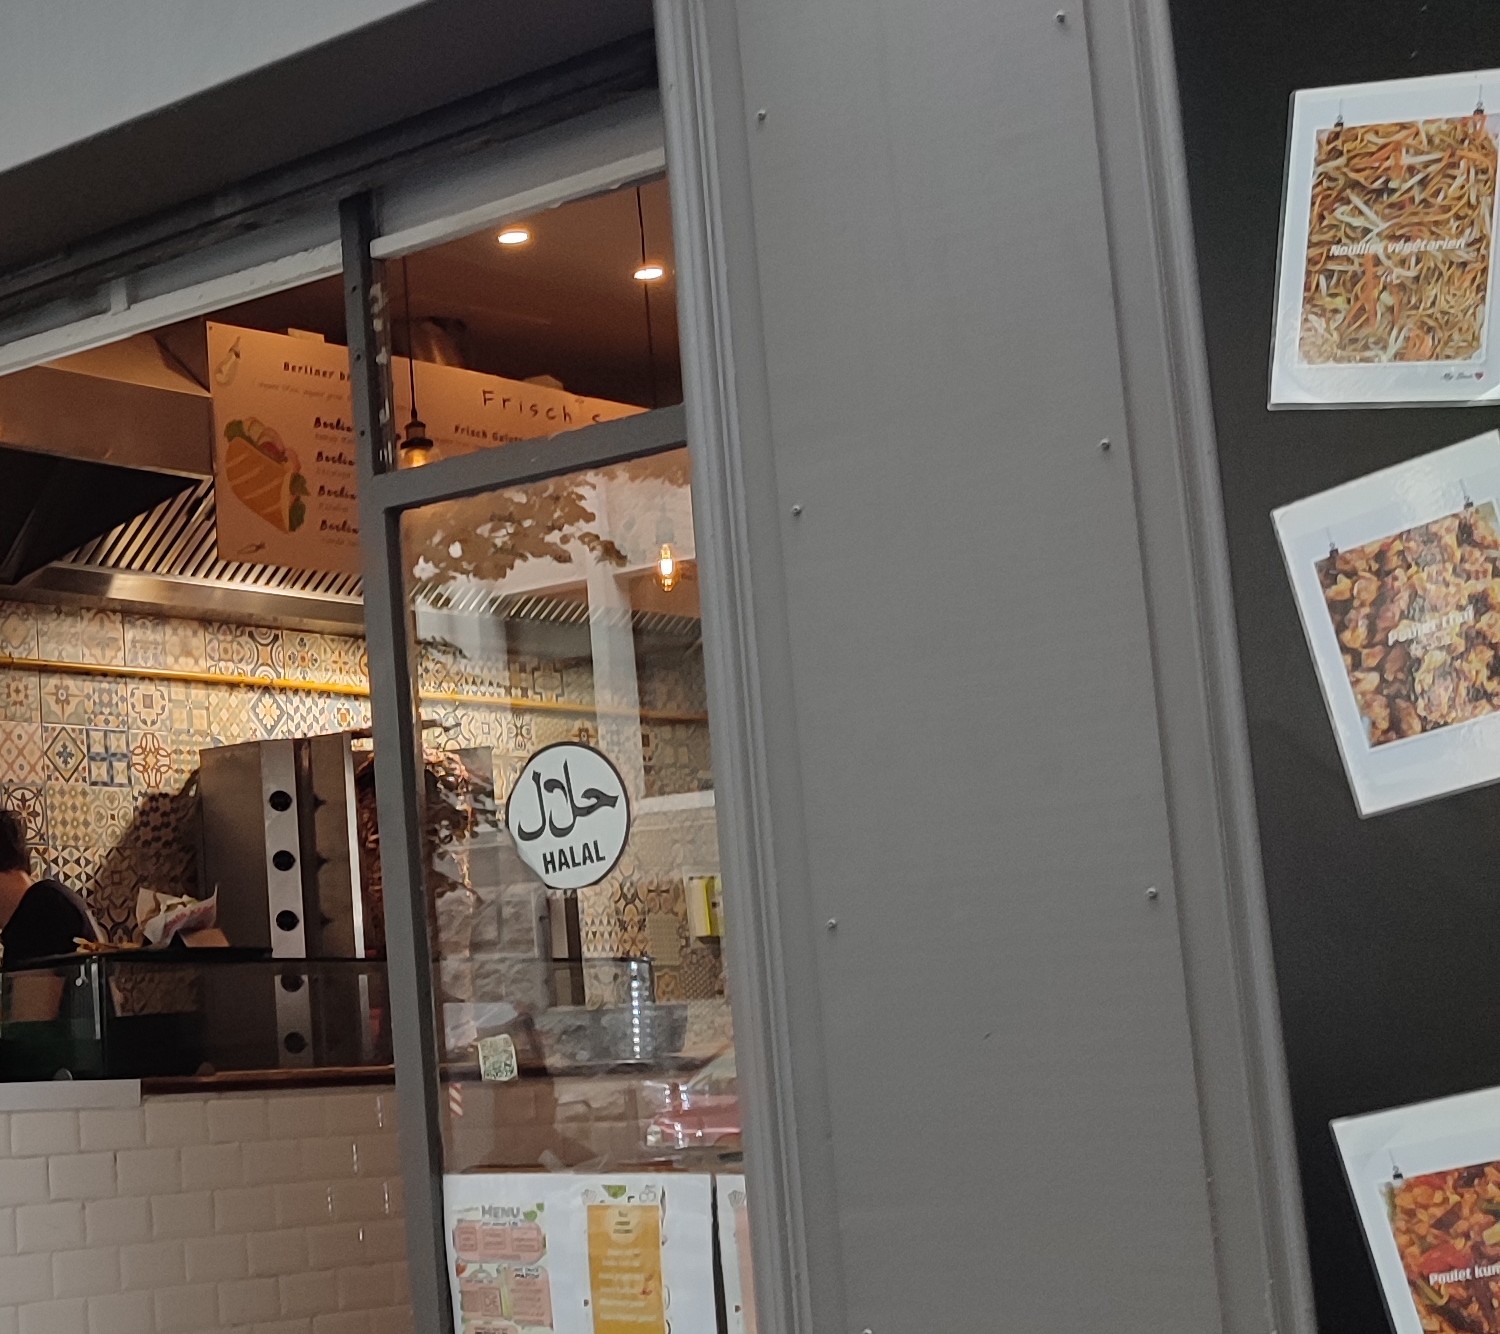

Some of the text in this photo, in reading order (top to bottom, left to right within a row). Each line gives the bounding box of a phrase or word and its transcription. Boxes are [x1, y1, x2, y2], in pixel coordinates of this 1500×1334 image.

[283, 361, 335, 379] Berliner
[481, 389, 573, 424] Frisch
[516, 758, 619, 842] حلال
[542, 840, 606, 875] HALAL
[1428, 1268, 1473, 1287] Poulet
